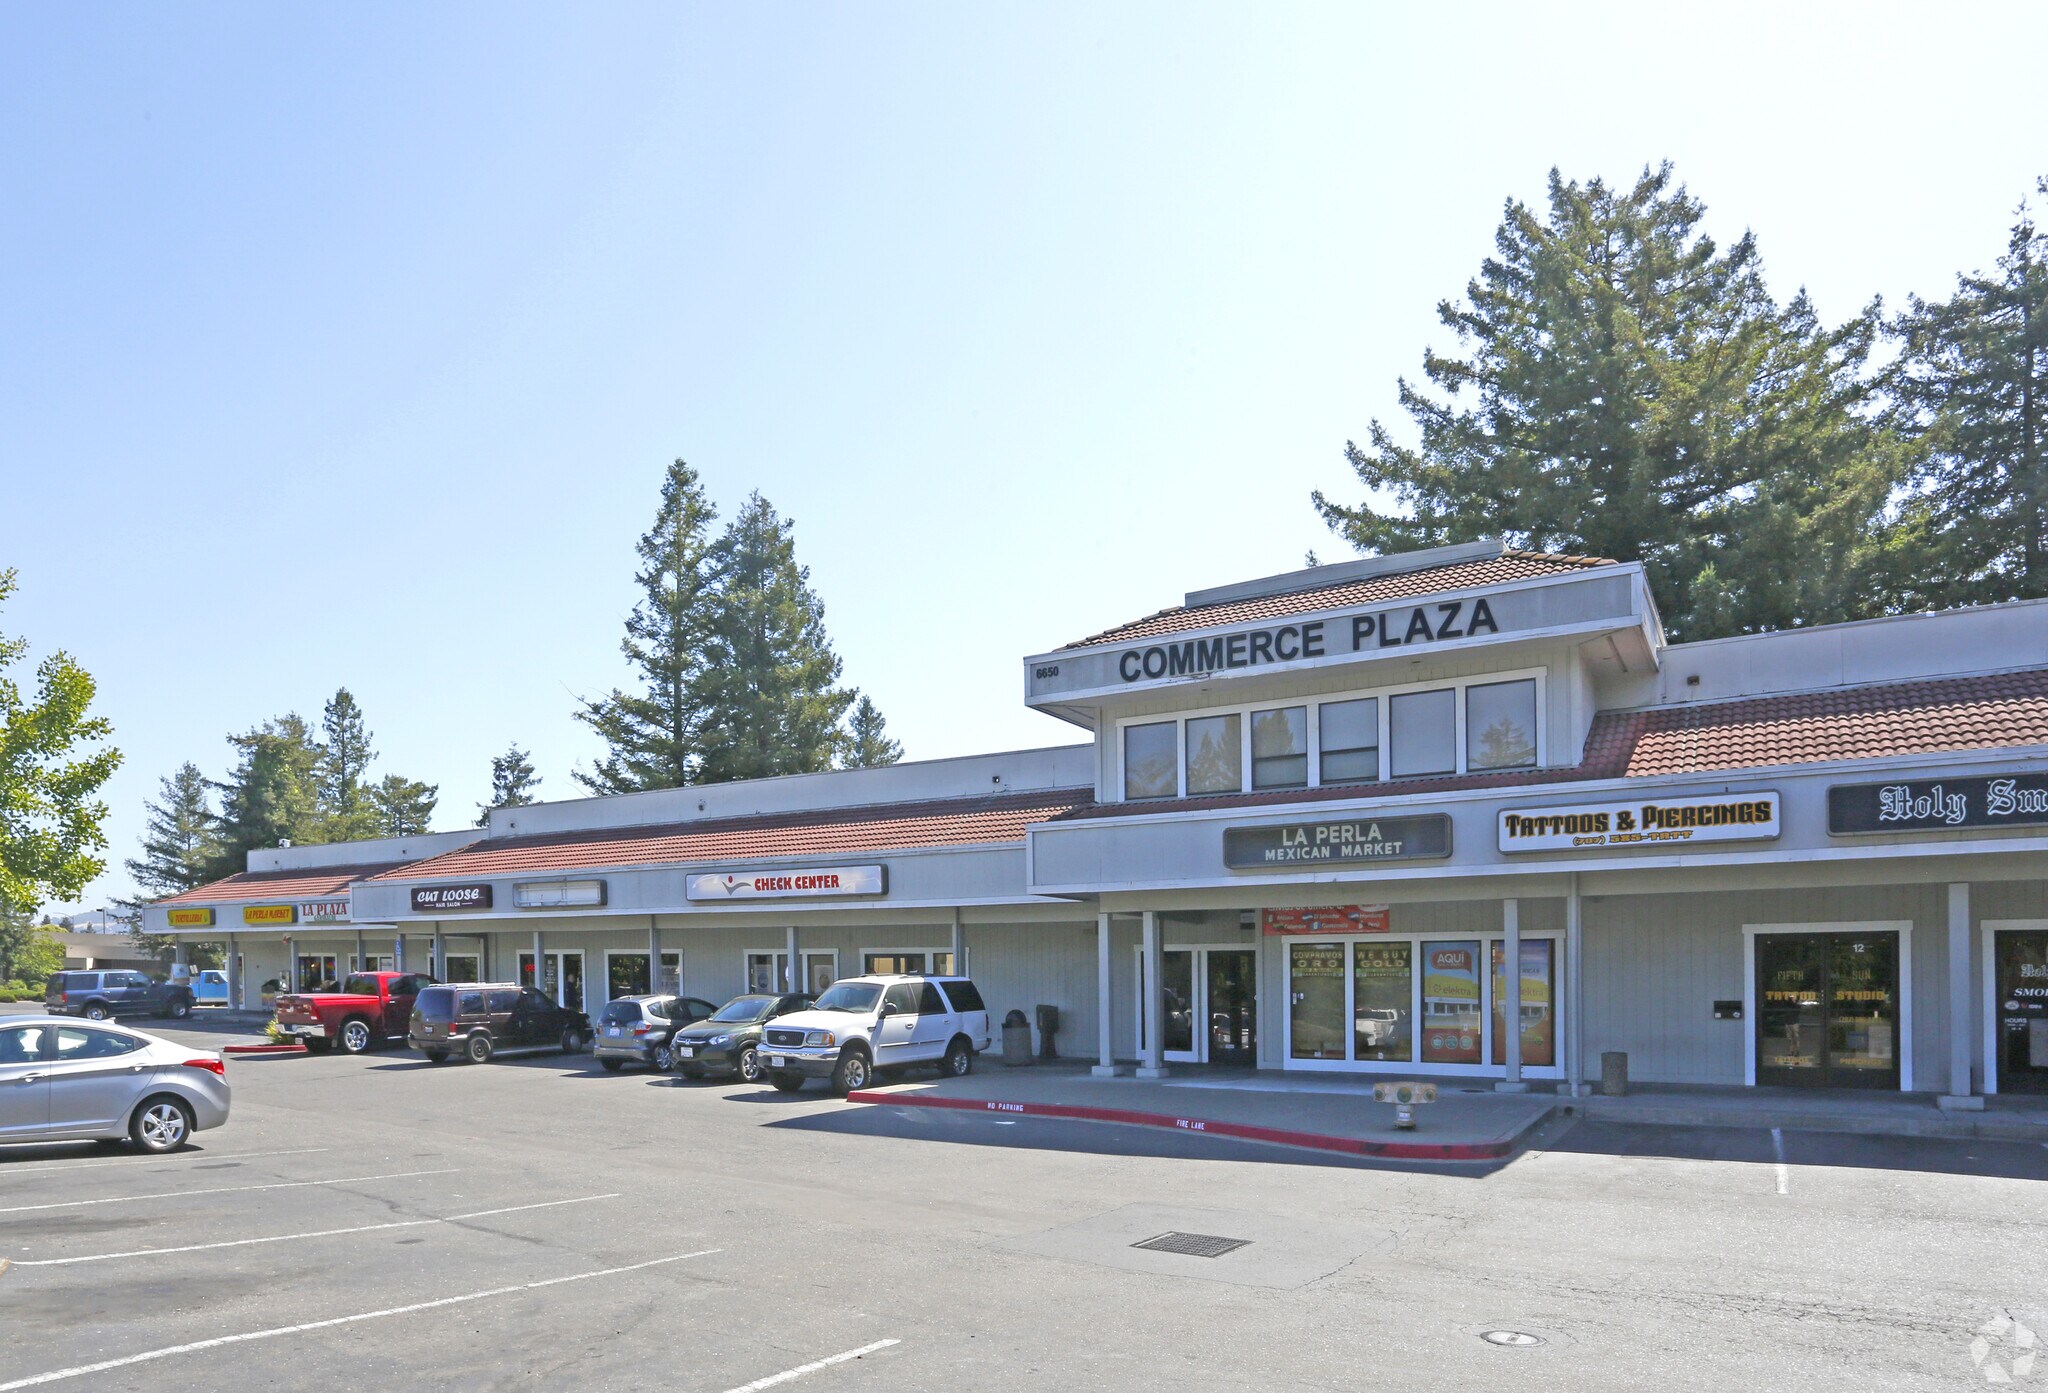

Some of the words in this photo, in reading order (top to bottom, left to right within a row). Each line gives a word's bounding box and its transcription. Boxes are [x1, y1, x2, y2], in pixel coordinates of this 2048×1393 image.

[1119, 622, 1325, 682] COMMERCE
[1352, 598, 1498, 652] PLAZA
[1036, 666, 1060, 680] 6650
[1879, 784, 1967, 824] Holy
[1616, 810, 1637, 832] &
[1282, 828, 1308, 846] LA
[1316, 823, 1382, 845] PERLA
[1573, 836, 1605, 846] (707)
[1609, 830, 1693, 844] 585-TATT
[1265, 846, 1330, 861] MEXICAN
[1341, 842, 1403, 857] MARKET
[754, 877, 792, 891] CHECK
[795, 874, 840, 889] CENTER
[417, 891, 439, 902] CUT
[442, 888, 480, 901] LOOSE
[302, 904, 314, 916] LA
[316, 903, 347, 916] PLAZA
[1852, 944, 1865, 953] 12
[1357, 951, 1374, 960] WE
[1383, 950, 1408, 959] BUY
[525, 963, 536, 972] OPE
[1297, 960, 1338, 968] ORO
[1360, 960, 1405, 968] GOLD
[1777, 970, 1804, 980] FIFTH
[1852, 969, 1871, 980] SUN
[1443, 986, 1472, 996] elektra
[1836, 991, 1885, 1001] STUDIO
[2013, 988, 2048, 997] SMO
[987, 1102, 996, 1110] NO
[998, 1103, 1024, 1112] PARKING
[1176, 1119, 1189, 1129] FIRE
[1191, 1121, 1205, 1131] LANE
